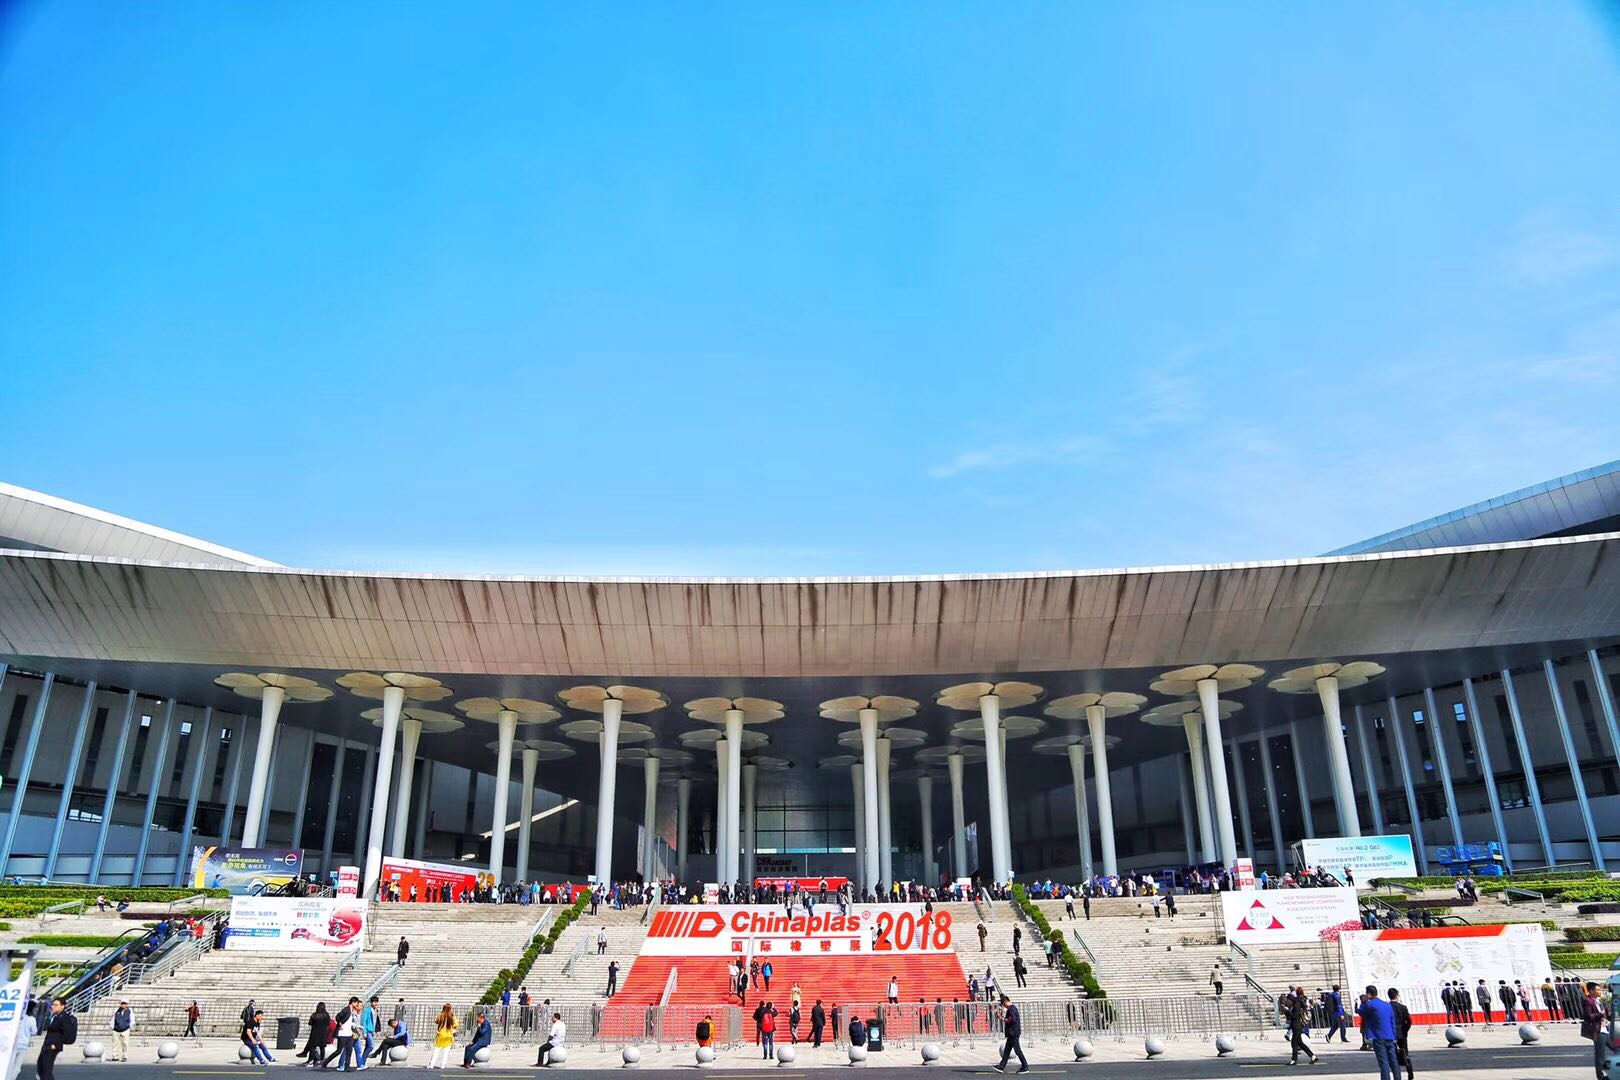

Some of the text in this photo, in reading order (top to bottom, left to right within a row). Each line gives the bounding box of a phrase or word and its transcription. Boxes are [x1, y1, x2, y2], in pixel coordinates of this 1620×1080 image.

[731, 911, 952, 950] Chinaplas 2018
[731, 940, 861, 952] 国际橡塑展
